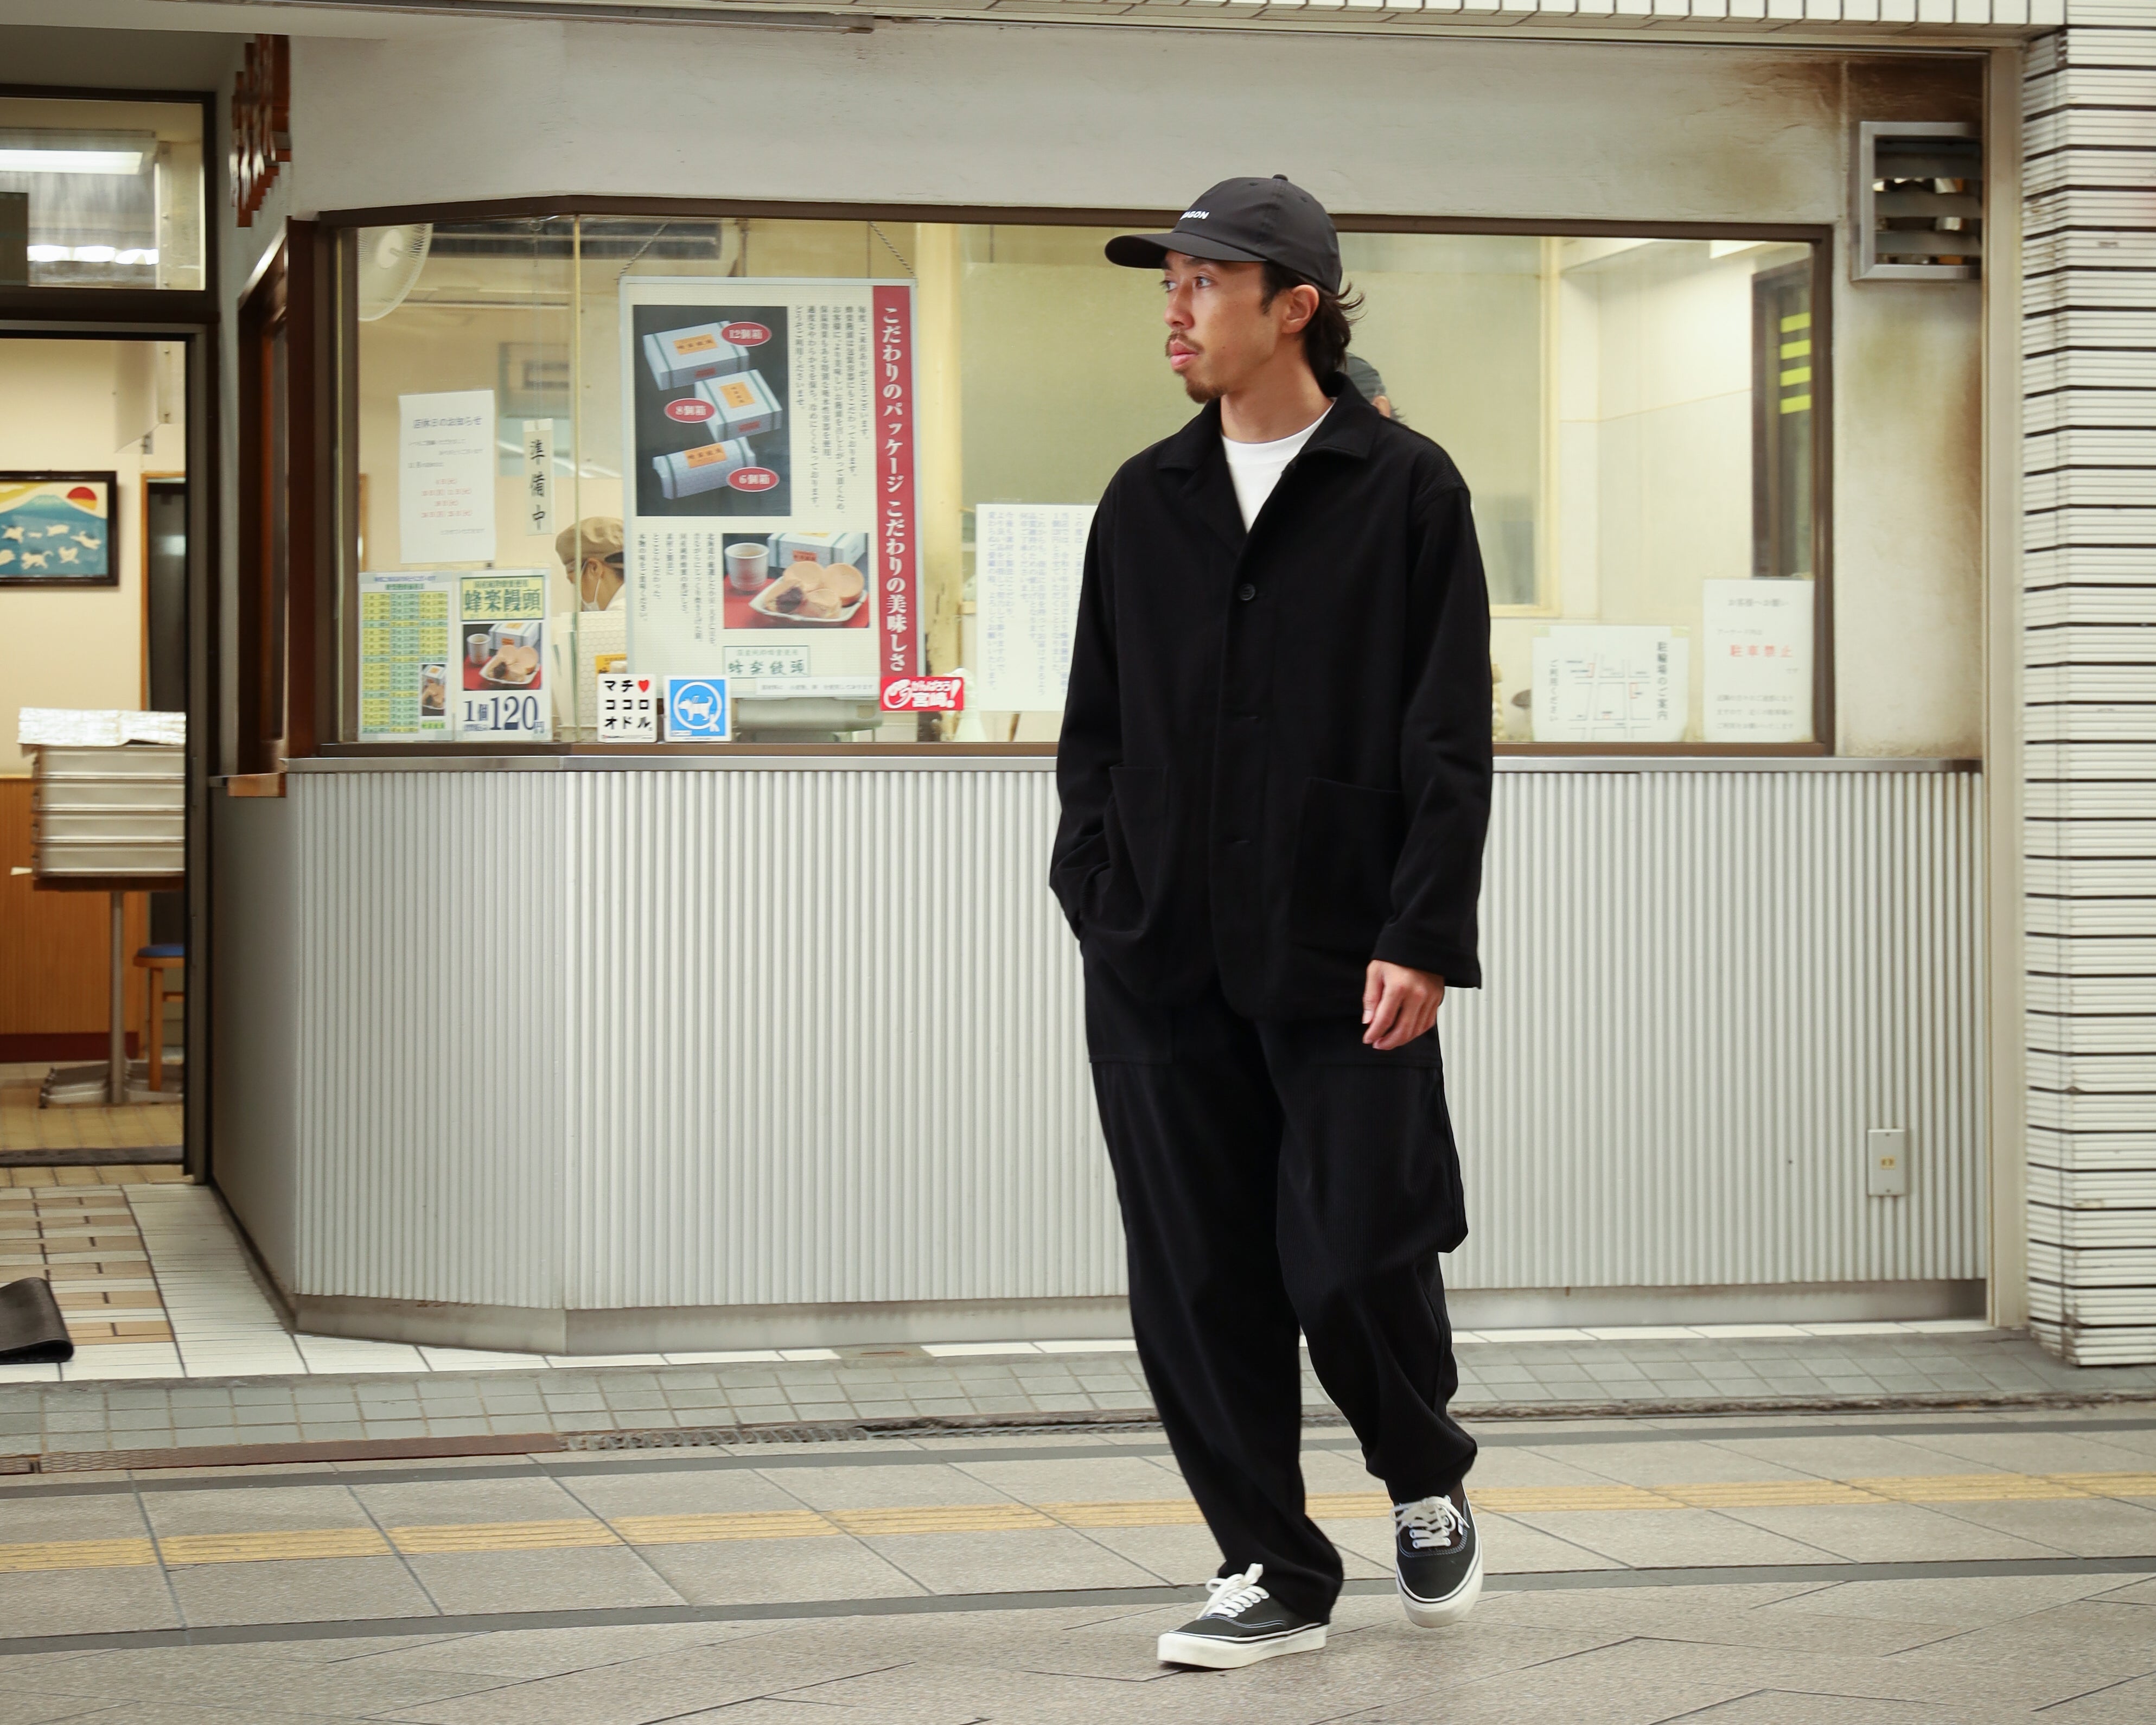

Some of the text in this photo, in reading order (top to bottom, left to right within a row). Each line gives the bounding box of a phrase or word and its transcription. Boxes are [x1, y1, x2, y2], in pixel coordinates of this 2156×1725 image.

[729, 329, 763, 340] 12個箱
[675, 405, 707, 416] 8個箱
[528, 438, 546, 531] 準備中
[738, 474, 770, 486] 6個箱
[882, 307, 908, 672] こだわりのパッケージ こだわりの美味しさ
[464, 589, 541, 613] 蜂楽饅頭
[1730, 644, 1793, 658] 駐車禁止
[604, 680, 634, 692] マチ
[463, 700, 488, 722] 1個
[605, 699, 649, 710] ココロ
